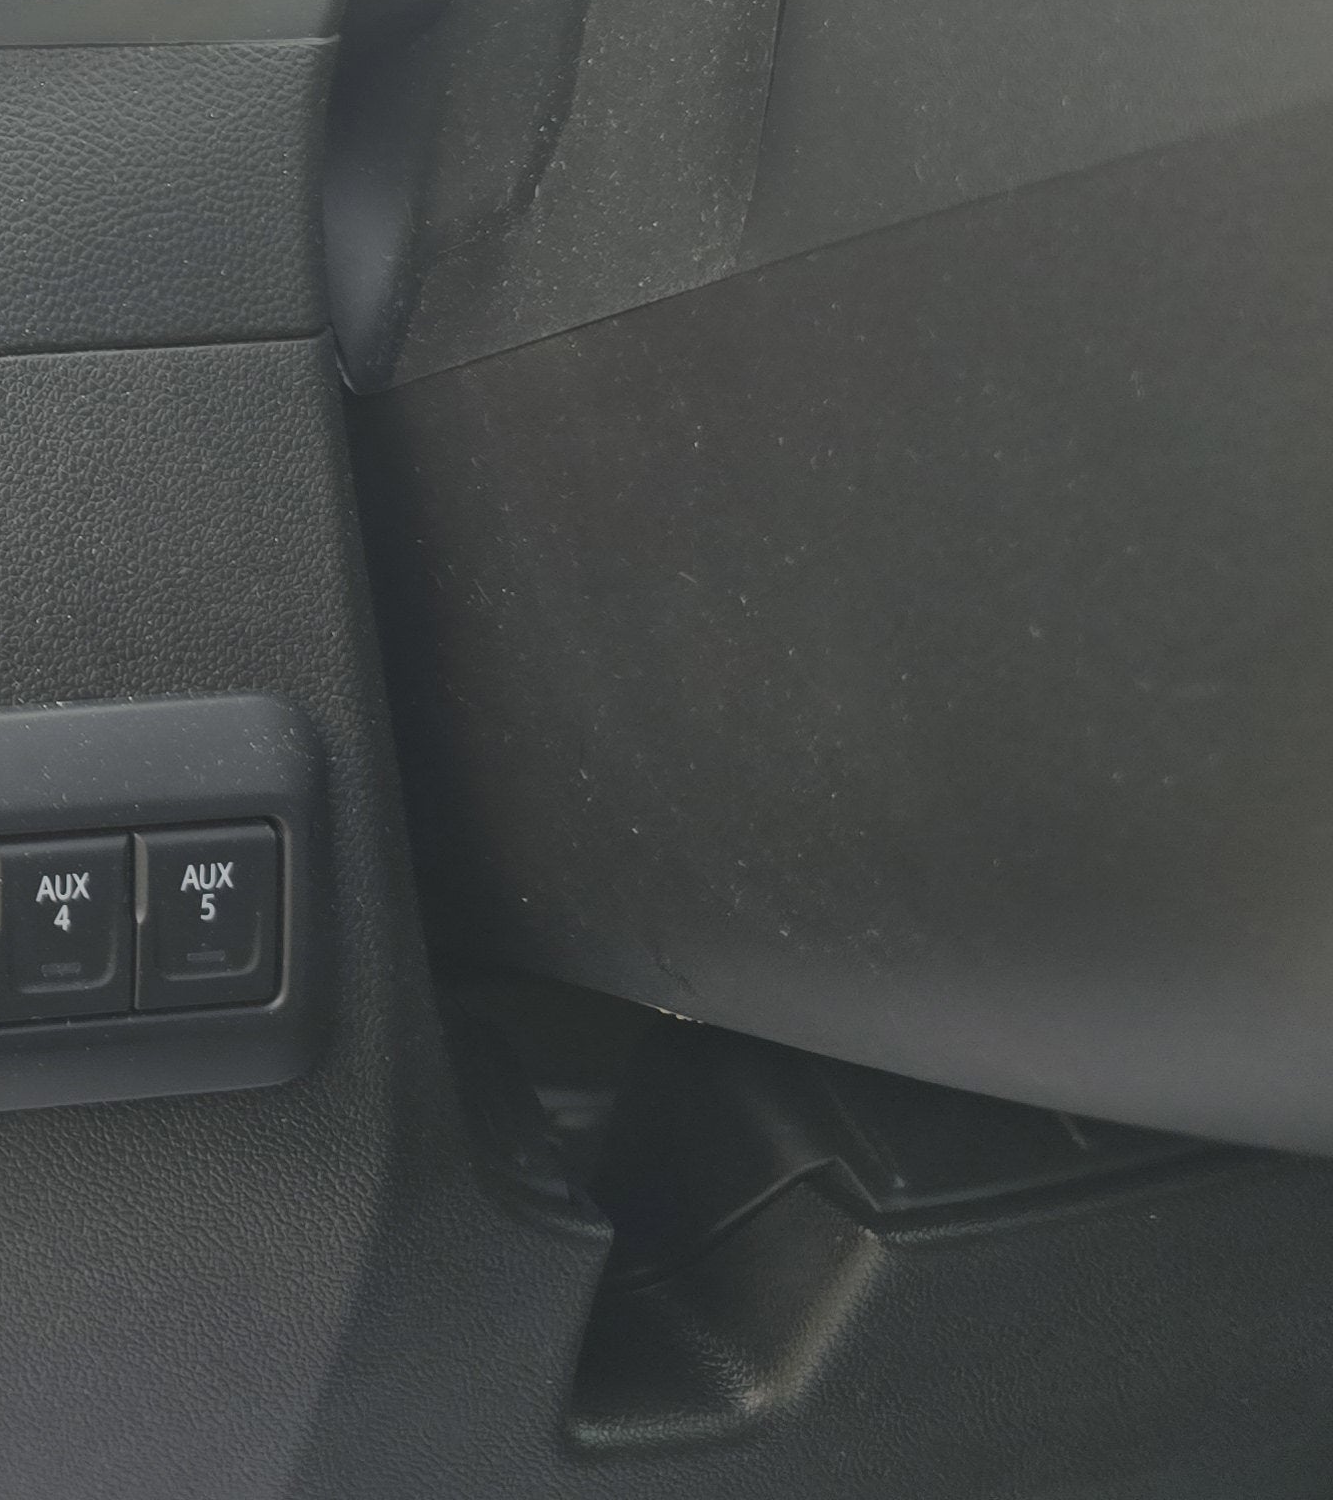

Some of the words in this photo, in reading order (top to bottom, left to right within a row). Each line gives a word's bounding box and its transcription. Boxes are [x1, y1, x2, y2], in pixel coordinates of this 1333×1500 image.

[35, 871, 90, 904] AUX
[182, 860, 235, 892] AUX
[53, 903, 71, 931] 4
[200, 893, 216, 921] 5
